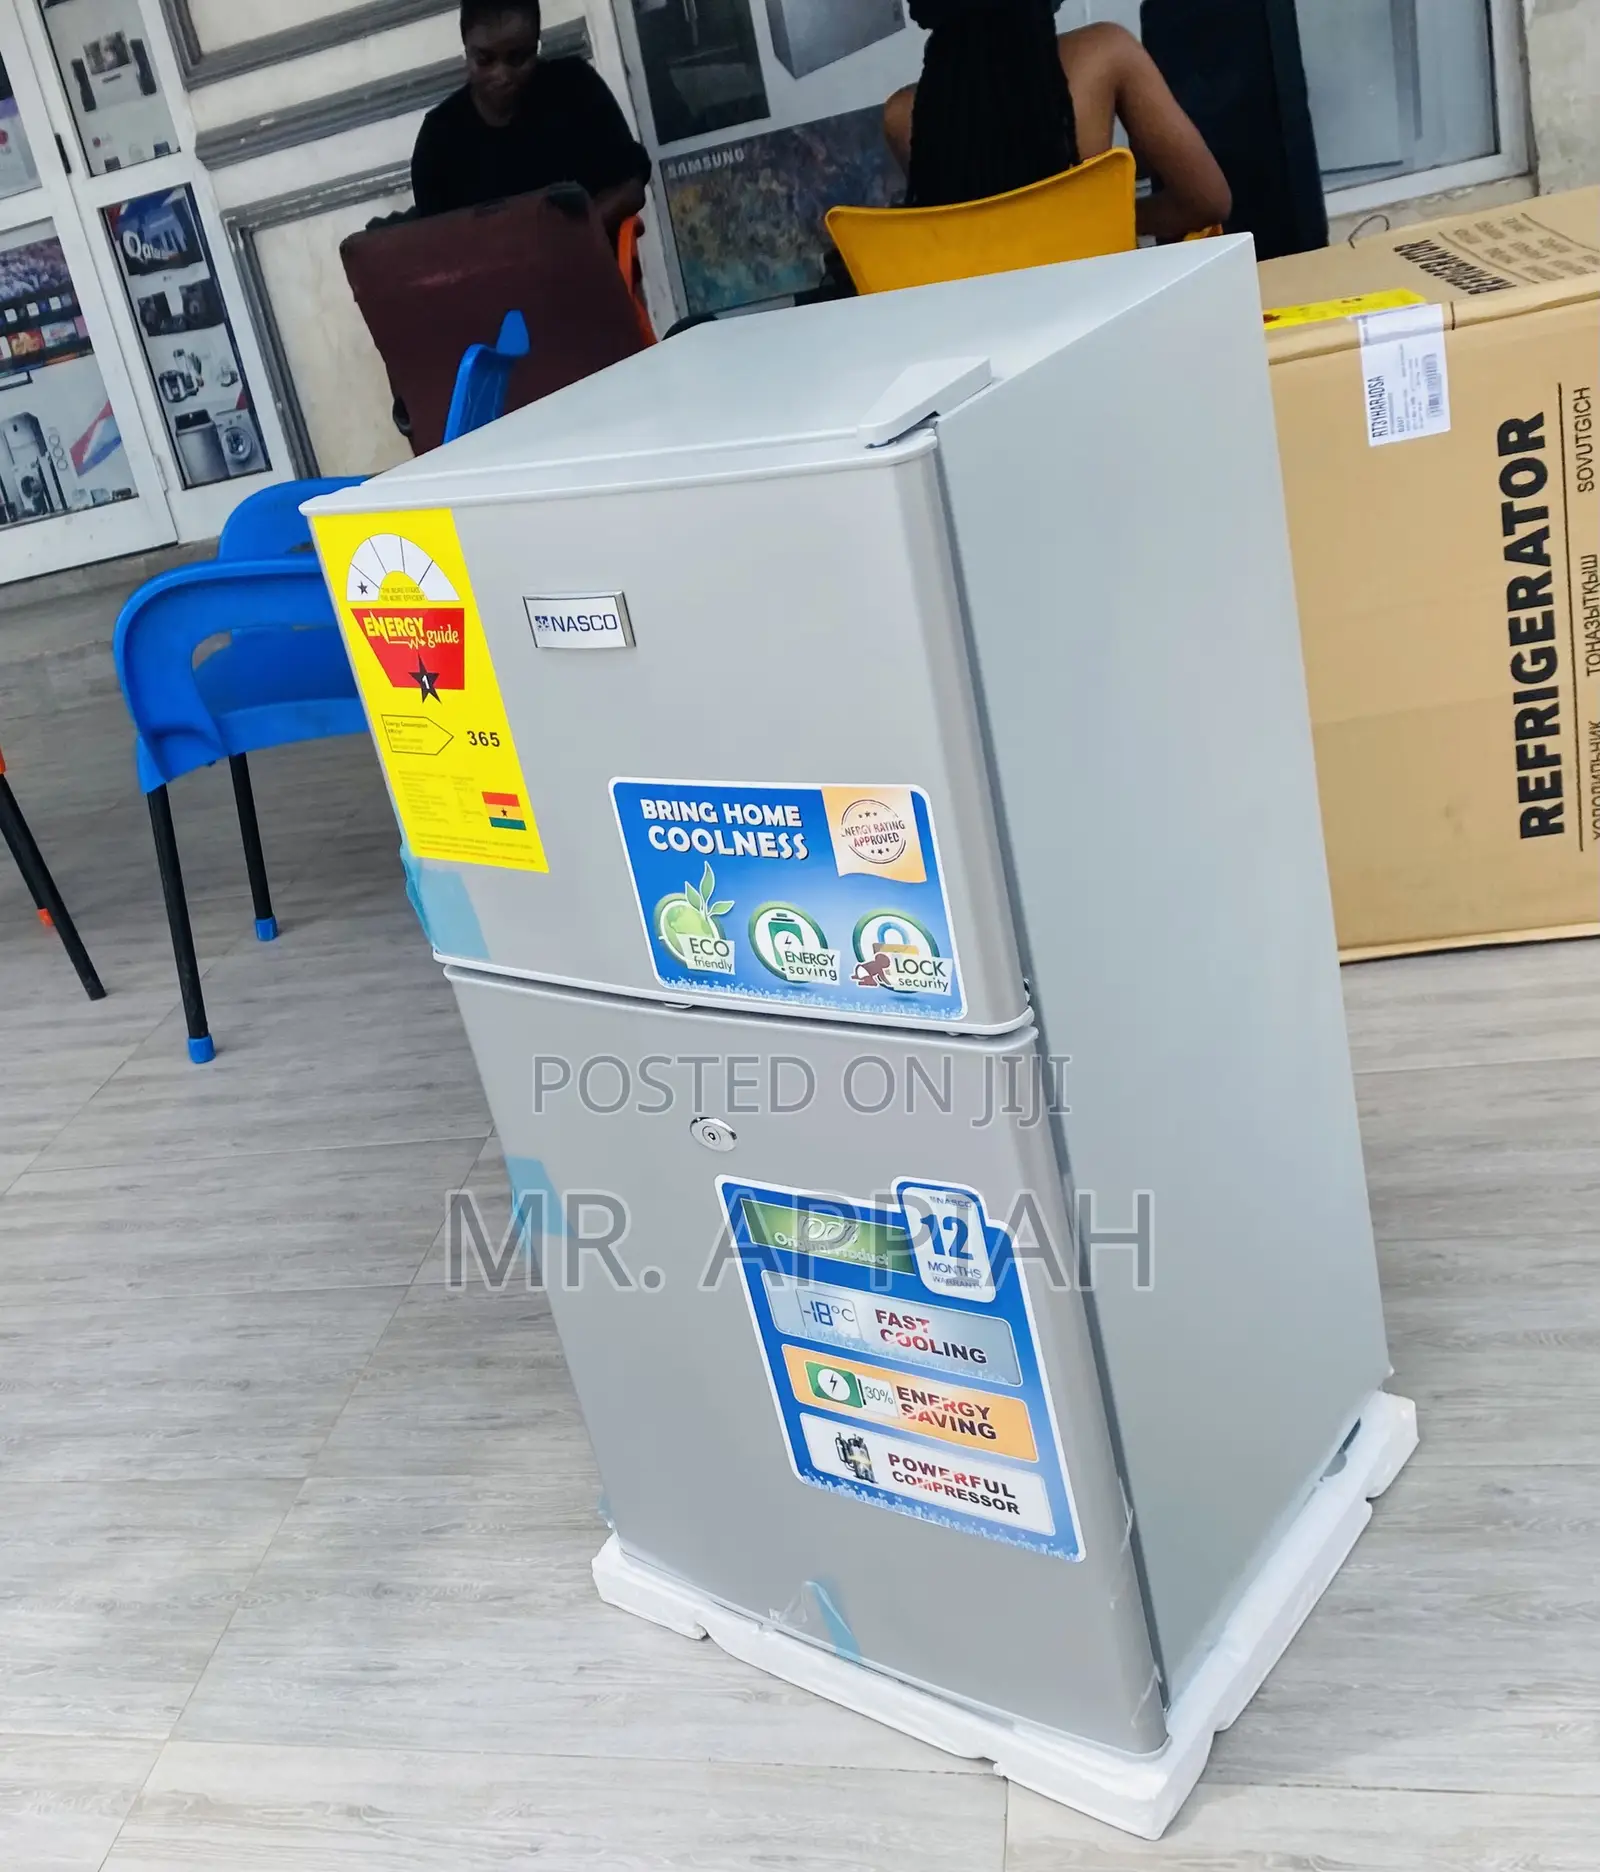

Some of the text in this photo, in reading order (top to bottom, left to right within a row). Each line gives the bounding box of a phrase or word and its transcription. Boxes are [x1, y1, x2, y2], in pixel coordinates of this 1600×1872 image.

[668, 147, 745, 178] SAMSUNG
[1393, 239, 1517, 295] REFRIGERATOR
[1573, 386, 1595, 492] SOVUTGICH
[363, 611, 426, 642] ENERGY
[550, 614, 618, 632] NASCO
[1497, 411, 1565, 839] REFRIGERATOR
[426, 624, 459, 648] guide
[422, 675, 430, 689] 1
[467, 730, 500, 747] 365
[640, 799, 803, 827] BRING HOME
[841, 820, 905, 837] NERGY RATING
[853, 832, 900, 847] APPROVED
[648, 825, 809, 860] COOLNESS
[689, 938, 729, 957] ECO
[785, 951, 835, 966] ENERGY
[694, 956, 732, 972] friendly
[789, 965, 838, 981] saving
[895, 958, 946, 977] LOCK
[898, 977, 949, 992] security
[774, 1232, 831, 1254] Original
[920, 1214, 974, 1260] 12
[927, 1261, 982, 1278] MONTHS
[875, 1309, 930, 1333] FAST
[880, 1328, 987, 1364] COOLING
[864, 1385, 894, 1405] 30%
[896, 1385, 990, 1420] ENERGY
[901, 1403, 997, 1439] SAVING
[888, 1453, 1016, 1499] POWERFUL
[892, 1471, 1020, 1515] COMPRESSOR
